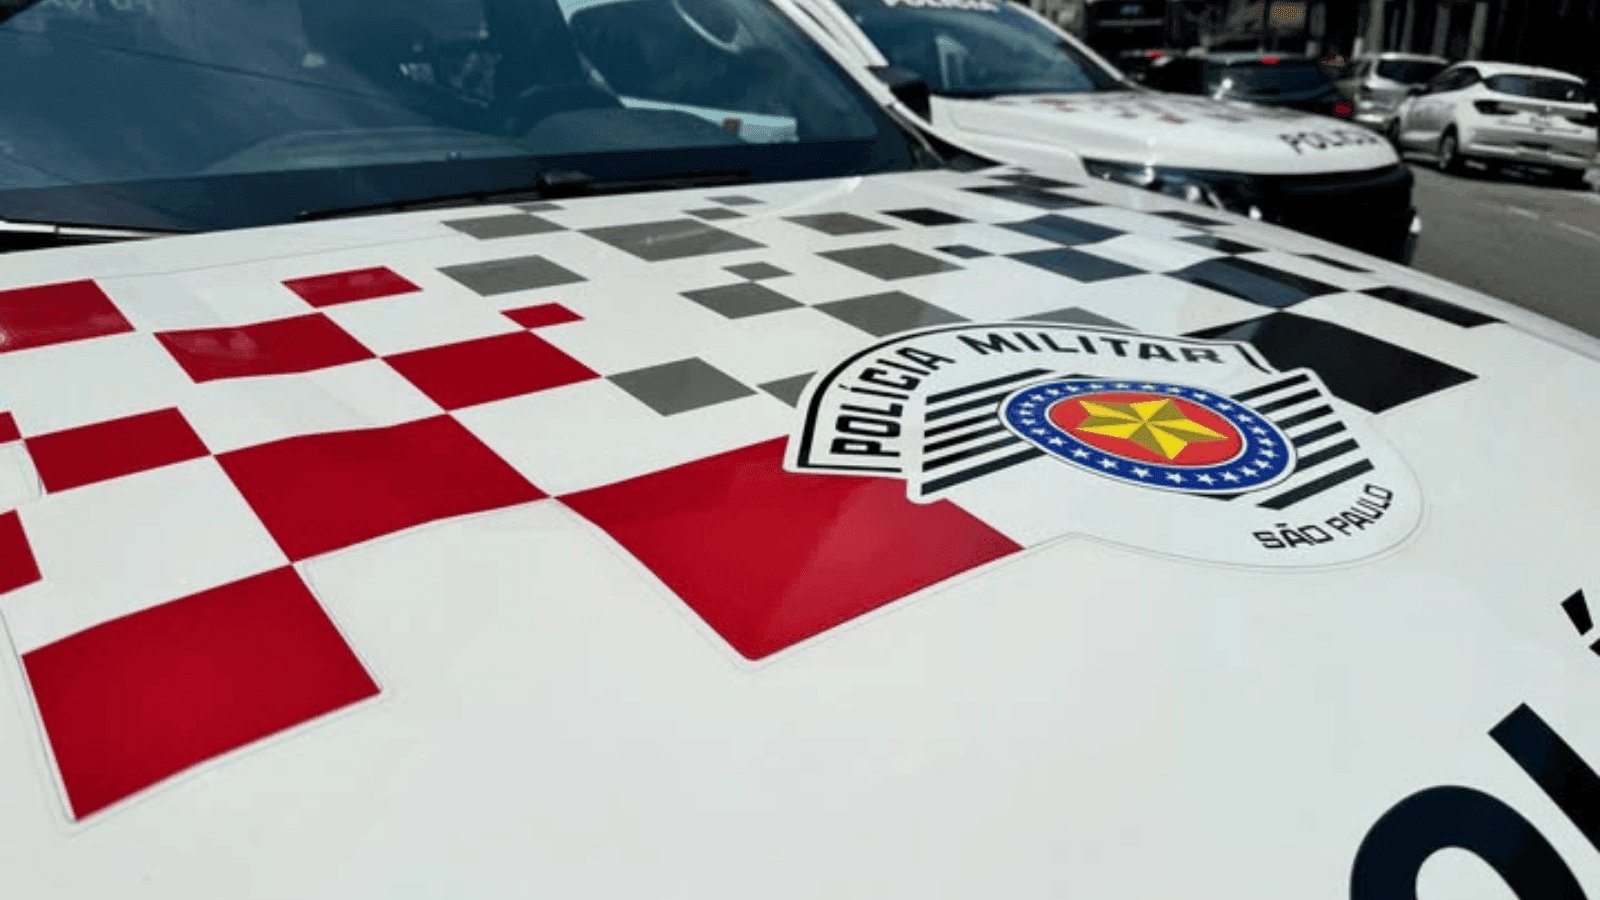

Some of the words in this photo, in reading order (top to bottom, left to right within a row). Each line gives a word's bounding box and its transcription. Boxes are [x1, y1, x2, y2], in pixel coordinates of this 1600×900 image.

[831, 347, 955, 458] POLÍCIA
[958, 333, 1222, 364] MILITAR
[1253, 523, 1334, 549] SÃO
[1325, 484, 1393, 536] PAULO
